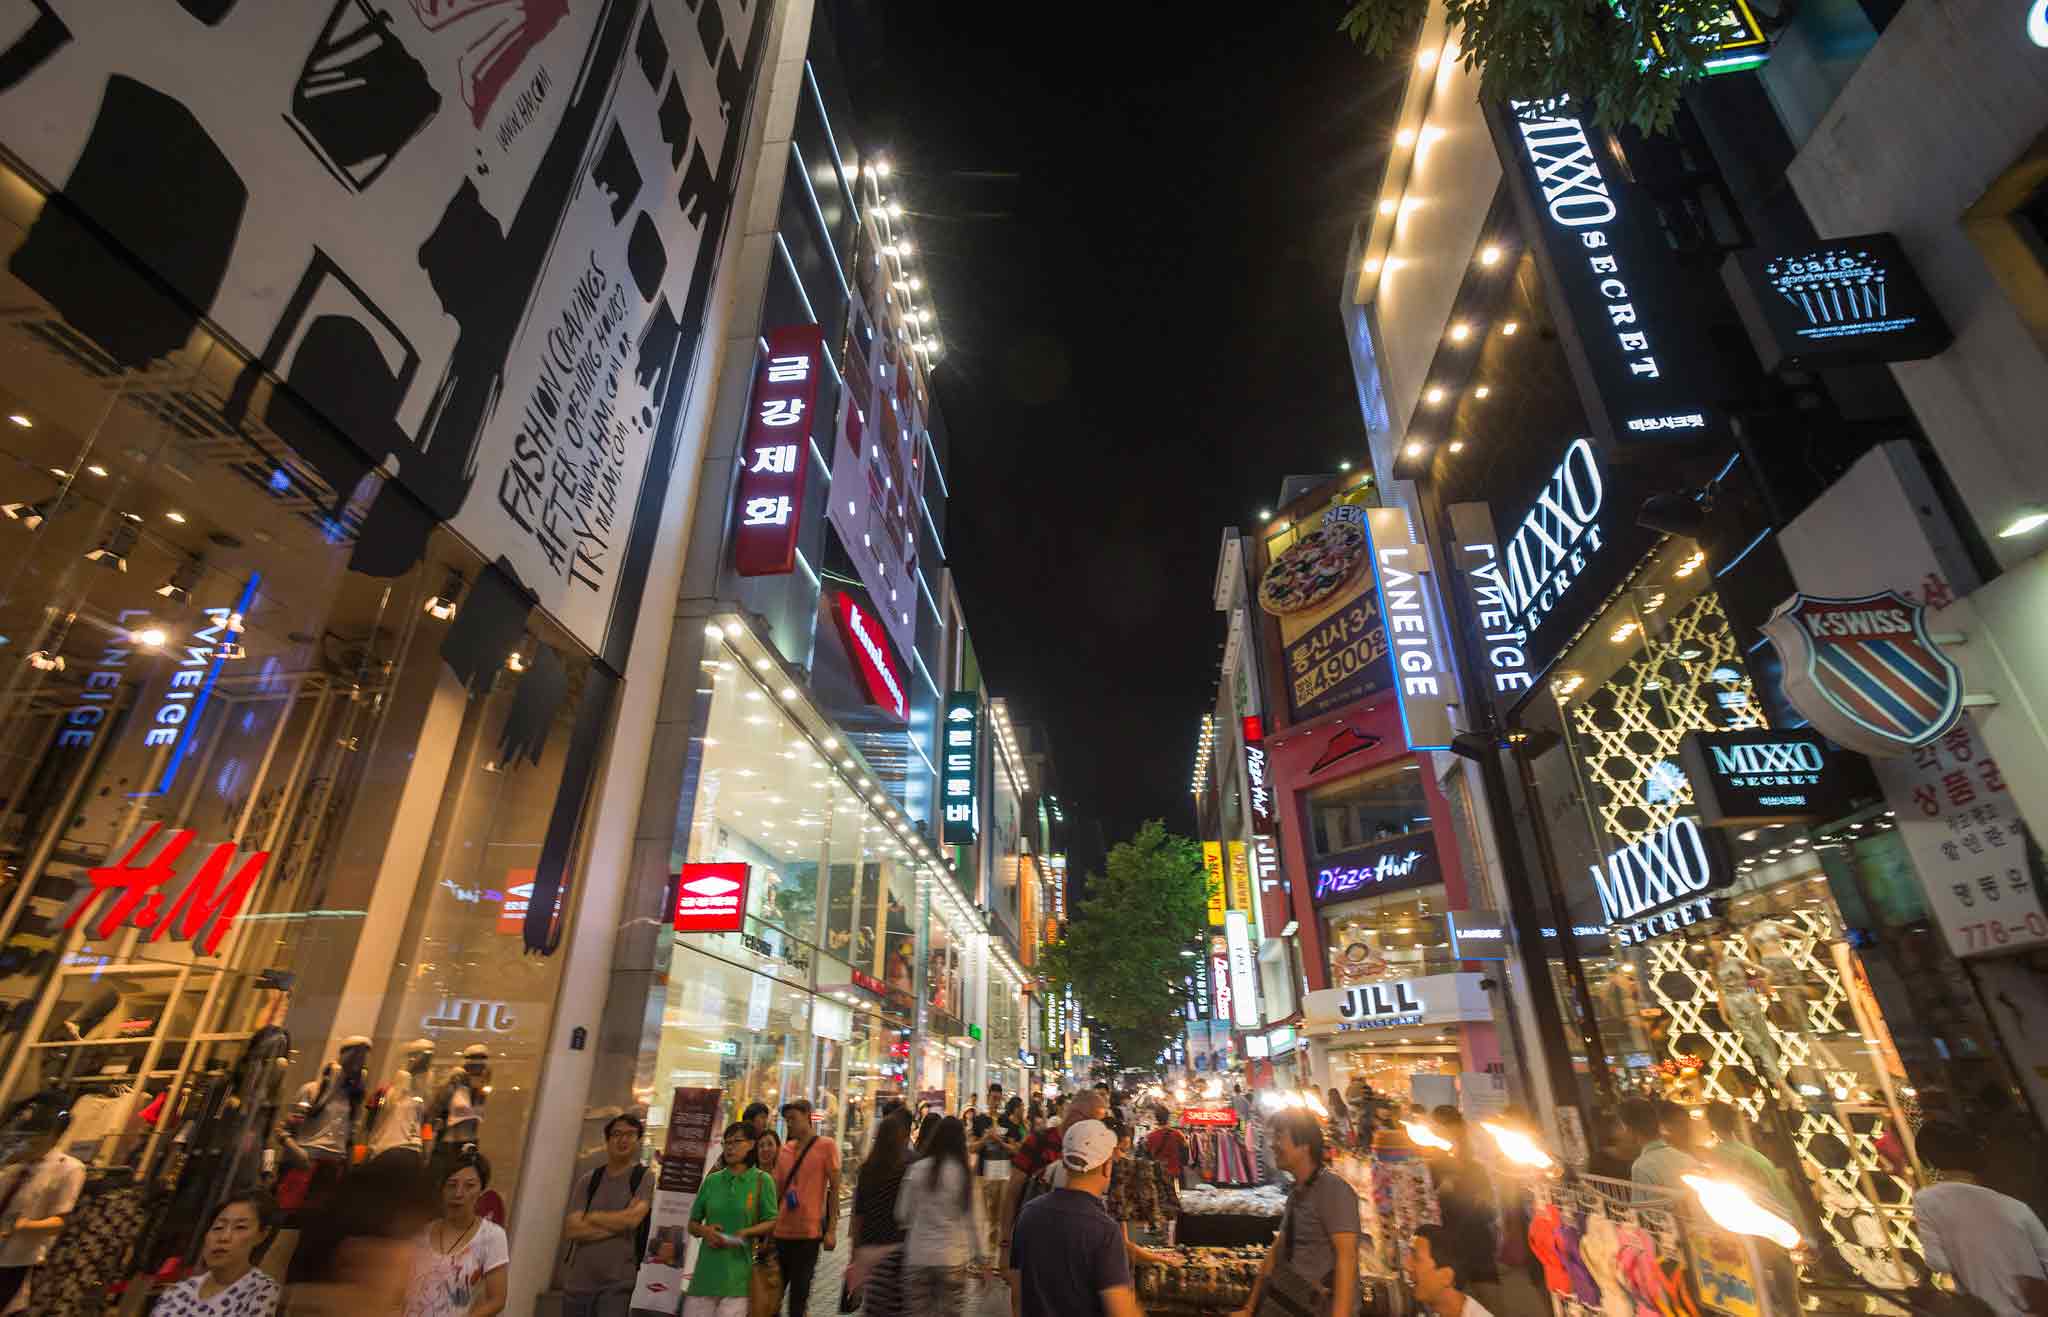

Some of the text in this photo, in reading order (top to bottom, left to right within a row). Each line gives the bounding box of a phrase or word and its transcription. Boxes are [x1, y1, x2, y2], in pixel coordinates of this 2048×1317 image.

[1580, 230, 1661, 378] SECRET
[498, 355, 563, 533] FASHION
[536, 447, 577, 577] AFTER
[564, 339, 602, 450] OPENING
[743, 355, 810, 526] 금강제화
[567, 505, 609, 592] TRY
[1325, 506, 1365, 524] NEW
[1493, 438, 1602, 633] MIXXO
[1379, 548, 1439, 696] LANEIGE
[1515, 524, 1603, 648] SECRET
[1710, 742, 1825, 775] MIXXO
[1730, 774, 1819, 787] SECRET
[64, 821, 271, 957] H&M
[1257, 843, 1280, 892] JILL
[1374, 849, 1424, 882] Hut
[1589, 816, 1711, 926] MIXXO
[1617, 896, 1714, 947] SECRET
[1340, 984, 1420, 1017] JILL
